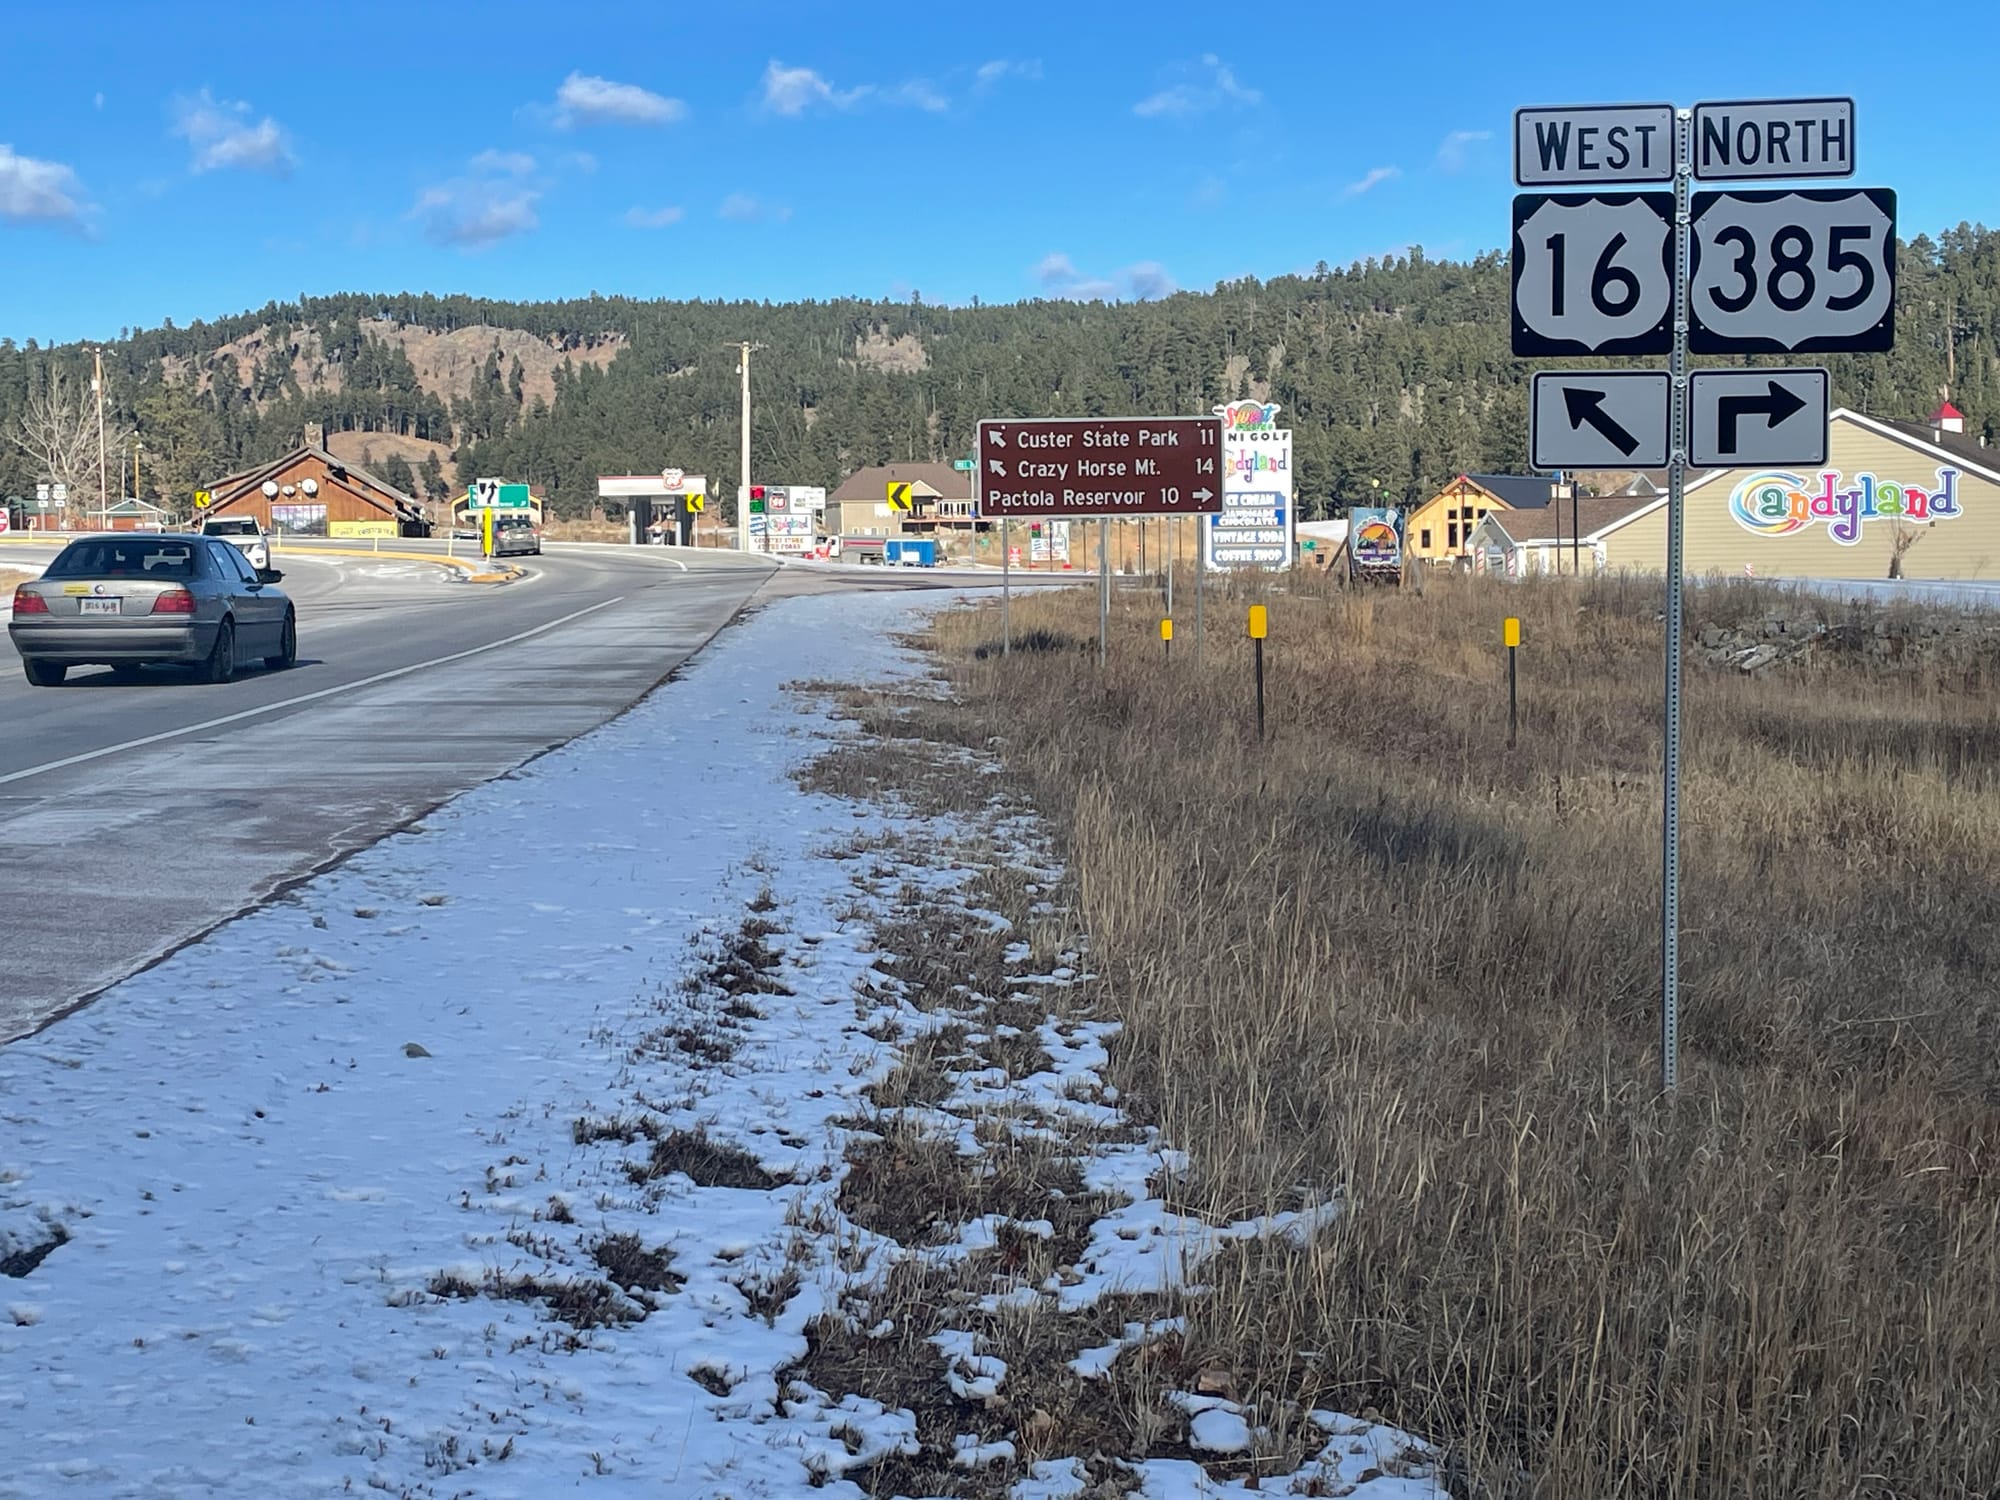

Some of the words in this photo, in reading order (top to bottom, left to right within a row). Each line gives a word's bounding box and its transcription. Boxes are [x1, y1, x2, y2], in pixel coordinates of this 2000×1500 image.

[1535, 121, 1656, 171] WEST
[1703, 116, 1845, 166] NORTH
[1545, 231, 1641, 318] 16
[1708, 224, 1875, 313] 385
[1223, 405, 1278, 429] Sweet
[1018, 431, 1073, 448] Custer
[1083, 430, 1129, 447] State
[1139, 429, 1179, 446] Park
[1200, 429, 1215, 445] 11
[1228, 432, 1244, 442] NI
[1250, 432, 1289, 441] GOLF
[1018, 460, 1068, 481] Crazy
[1078, 459, 1127, 476] Horse
[1135, 459, 1161, 476] Mt.
[1196, 457, 1214, 475] 14
[989, 490, 1055, 507] Pactola
[1063, 489, 1146, 506] Reservoir
[1160, 487, 1180, 504] 10
[1226, 494, 1239, 506] CE
[1240, 494, 1276, 506] CREAM
[1732, 470, 1958, 541] Candyland
[1213, 531, 1257, 543] VINTAGE
[1258, 531, 1285, 543] SODA
[1215, 549, 1253, 561] COFFEE
[1254, 549, 1282, 561] SHOP
